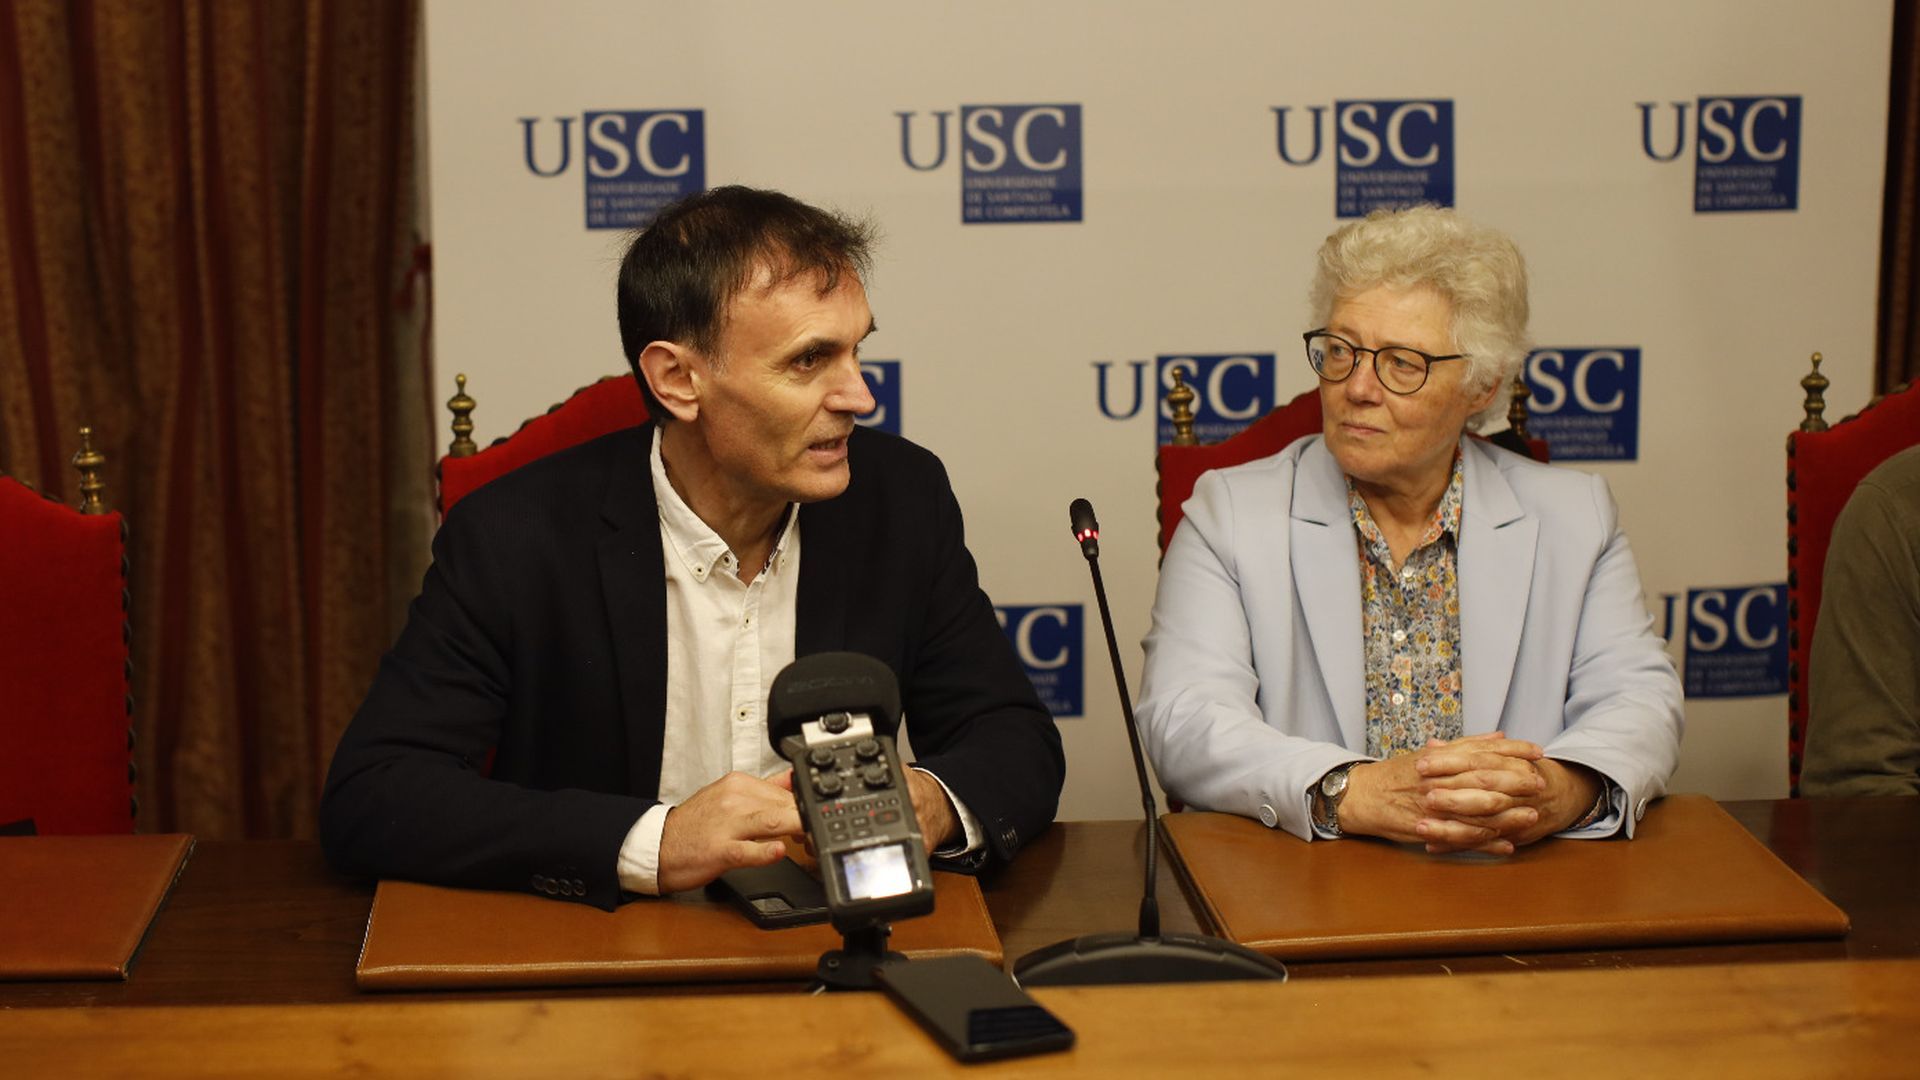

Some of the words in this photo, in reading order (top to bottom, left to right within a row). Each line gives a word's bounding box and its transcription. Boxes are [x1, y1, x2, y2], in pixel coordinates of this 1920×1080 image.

[515, 112, 690, 178] USC
[893, 107, 1067, 172] USC
[1269, 102, 1440, 167] USC
[1635, 98, 1788, 163] USC
[1527, 350, 1625, 414] SC
